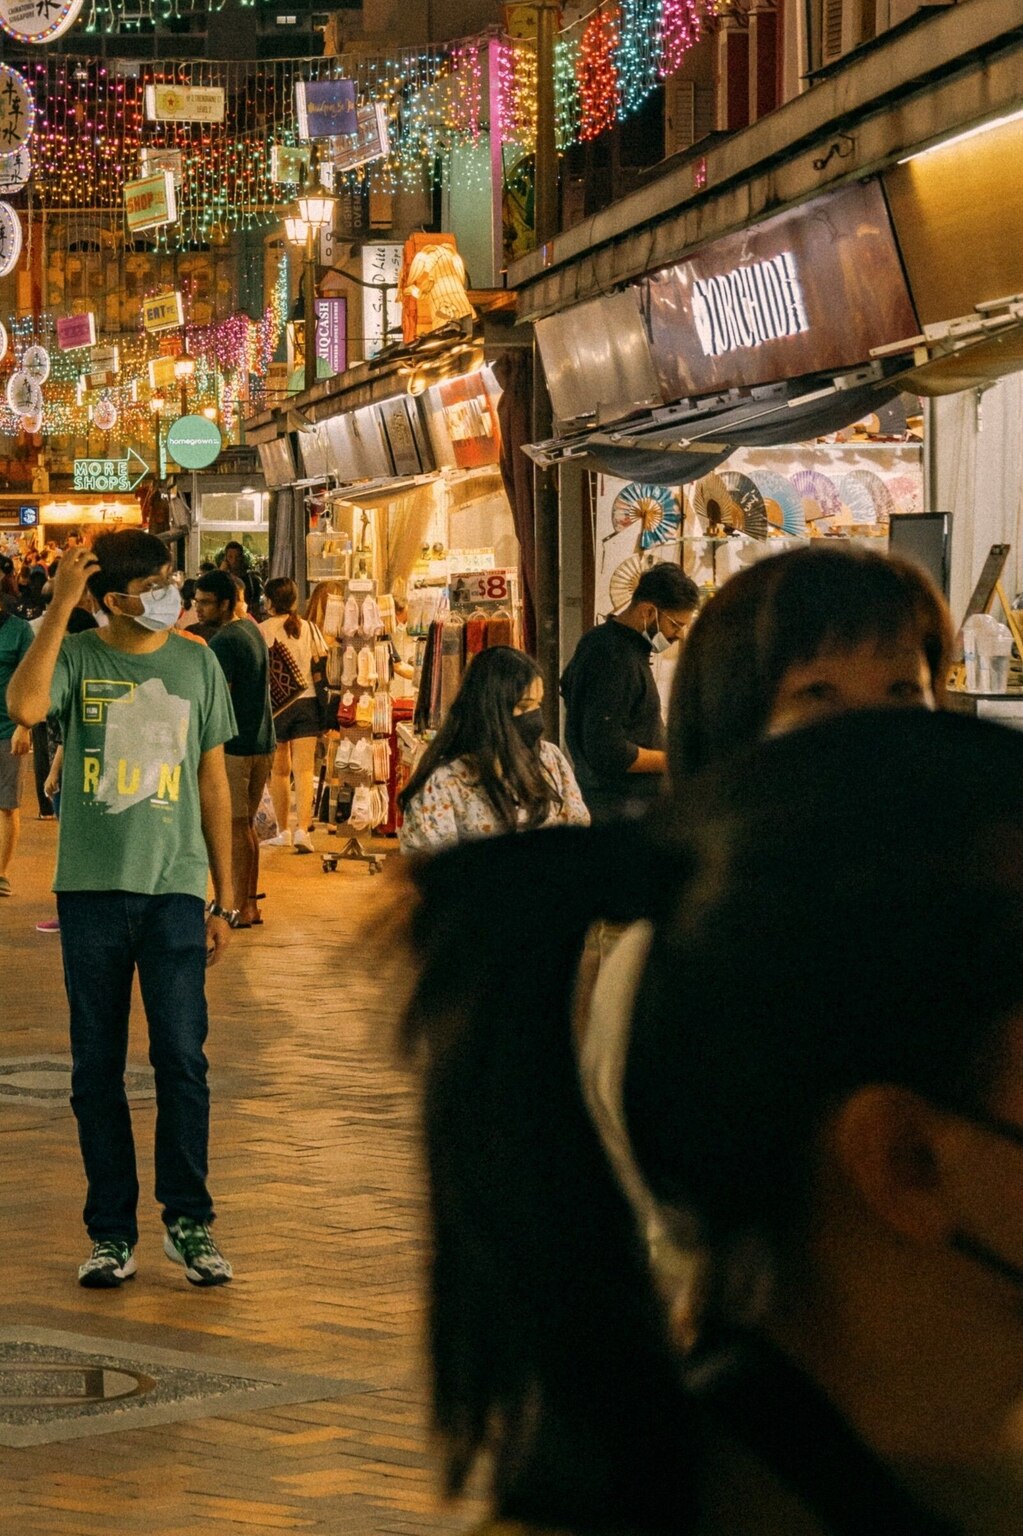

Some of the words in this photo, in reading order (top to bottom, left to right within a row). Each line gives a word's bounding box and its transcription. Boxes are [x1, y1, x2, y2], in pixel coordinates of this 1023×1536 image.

[127, 190, 154, 215] SHOP
[147, 304, 166, 321] EAT
[169, 437, 214, 447] homegrown
[73, 461, 128, 477] MORE
[73, 476, 129, 491] SHOPS
[478, 575, 507, 600] $8
[83, 756, 182, 802] RUN
